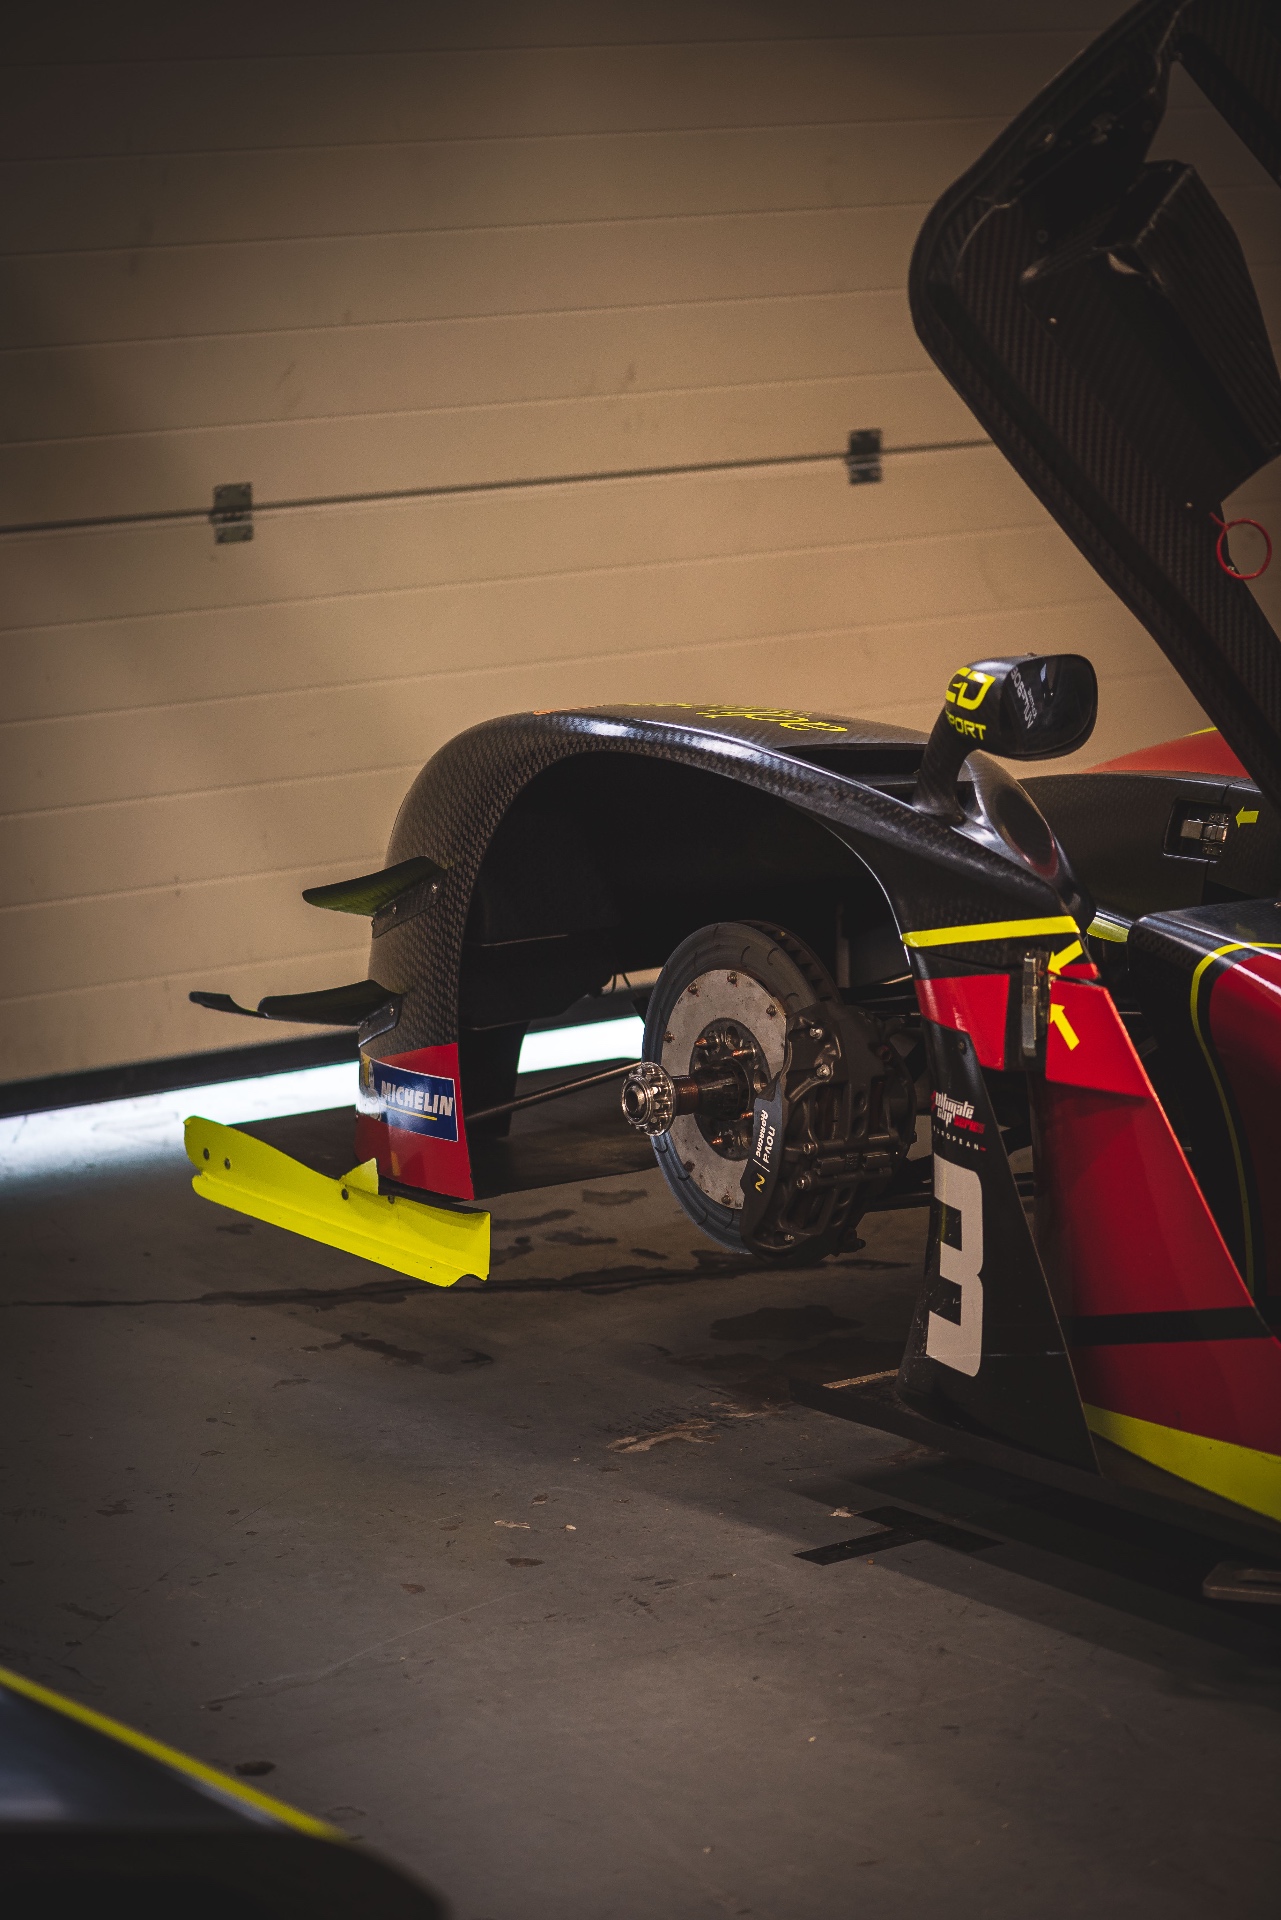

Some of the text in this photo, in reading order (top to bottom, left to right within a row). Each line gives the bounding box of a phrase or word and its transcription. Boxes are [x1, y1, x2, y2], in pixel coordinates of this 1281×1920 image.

[945, 709, 987, 740] PORT
[380, 1080, 454, 1117] MICHELIN
[926, 1152, 985, 1378] 3
